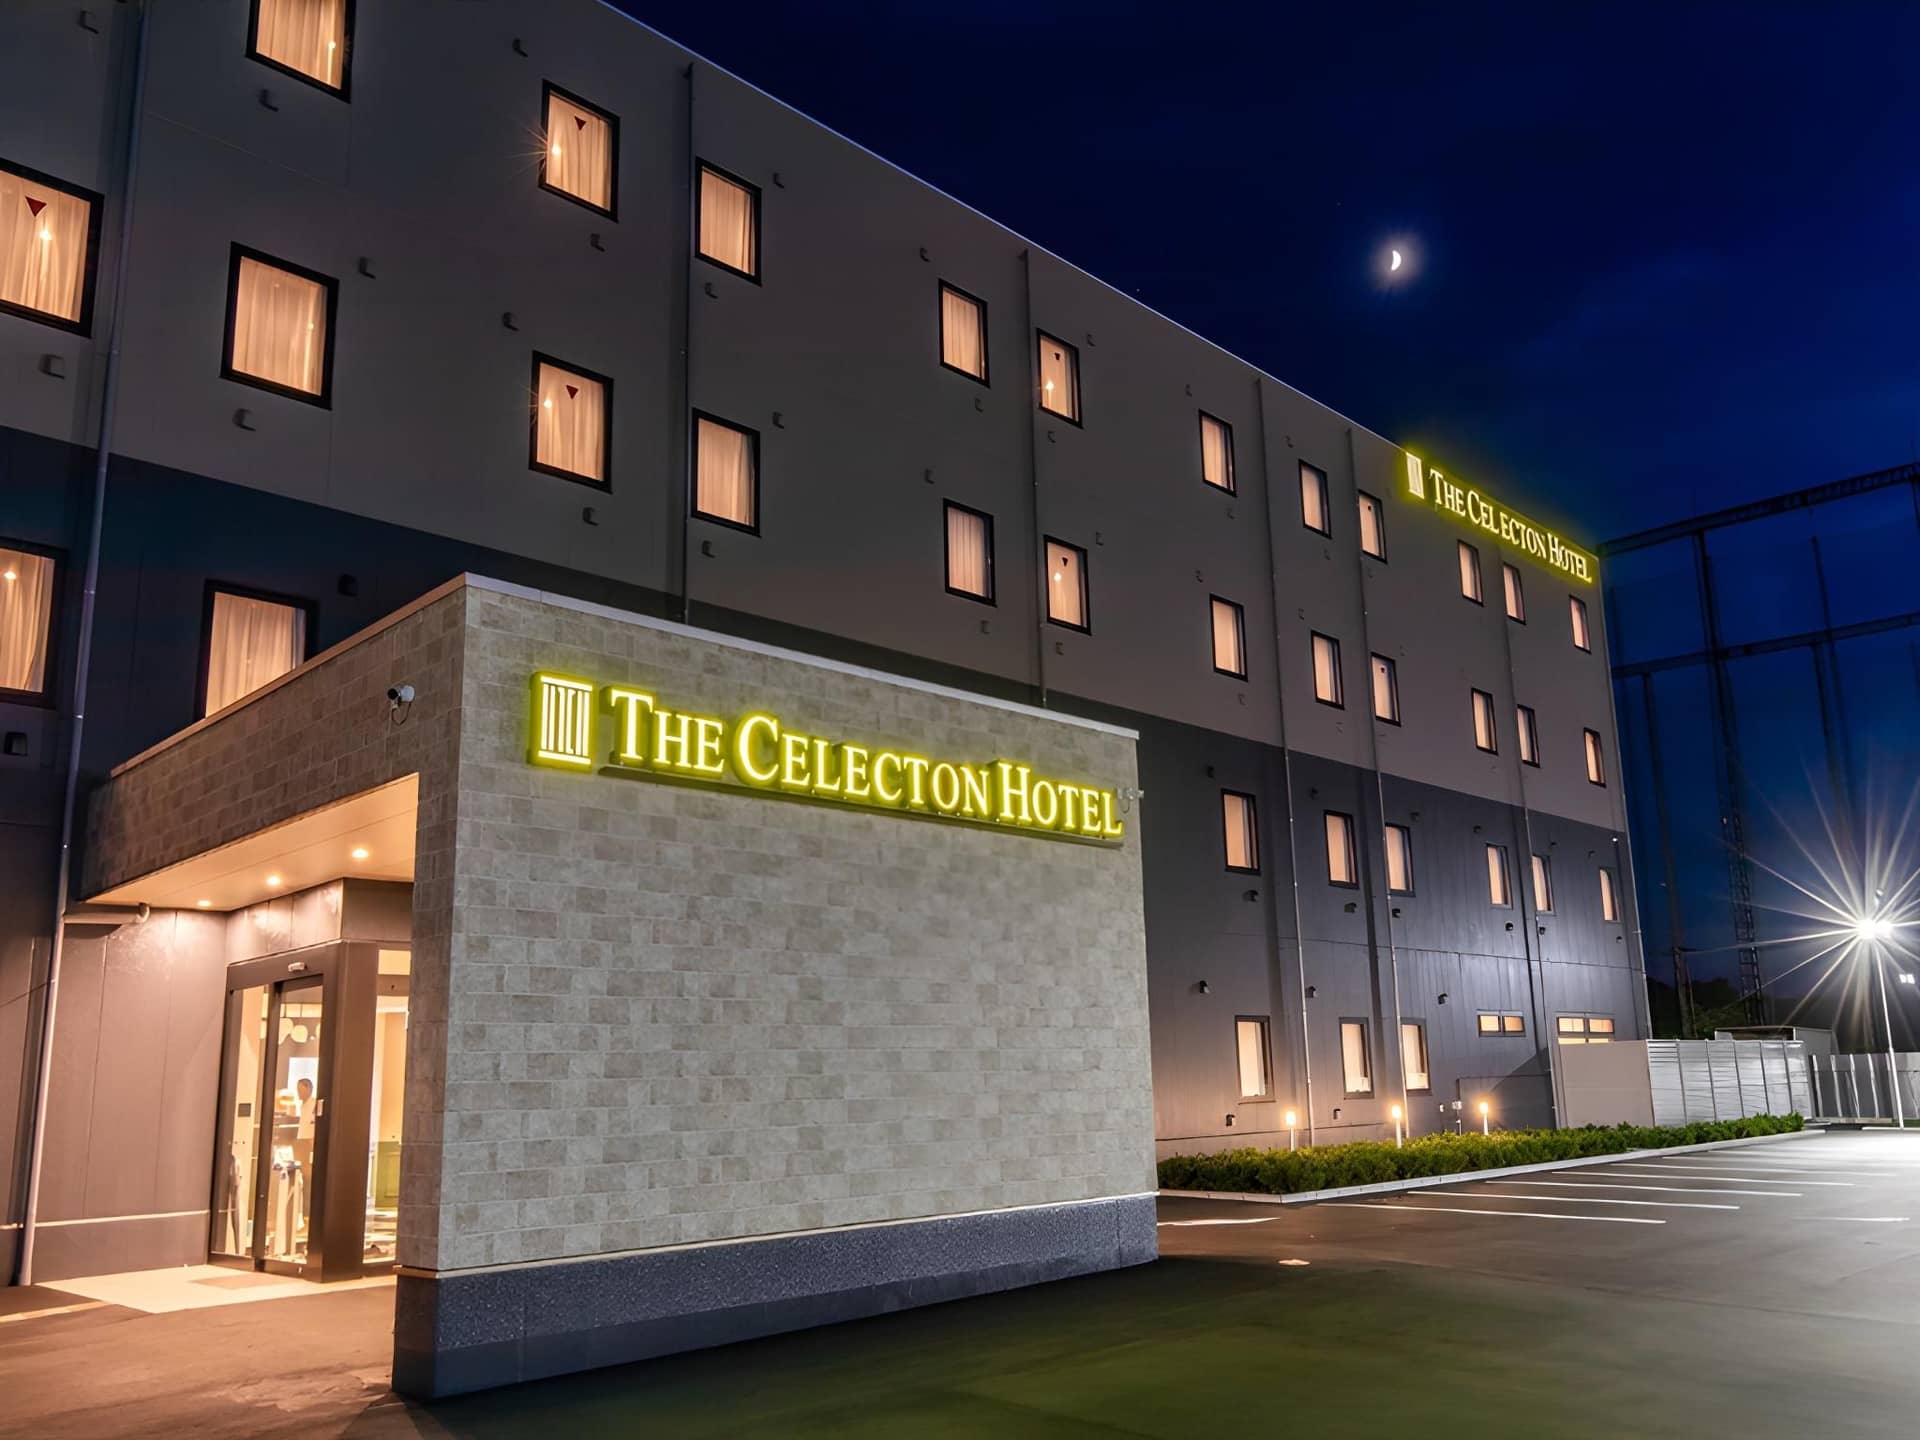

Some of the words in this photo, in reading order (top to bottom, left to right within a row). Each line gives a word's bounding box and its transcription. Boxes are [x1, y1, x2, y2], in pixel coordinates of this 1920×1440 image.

[1429, 468, 1466, 517] THE
[1467, 490, 1547, 559] CELECTON
[1547, 532, 1592, 583] HOTEL
[610, 688, 724, 773] THE
[738, 715, 989, 817] CELECTON
[1000, 761, 1123, 836] HOTEL
